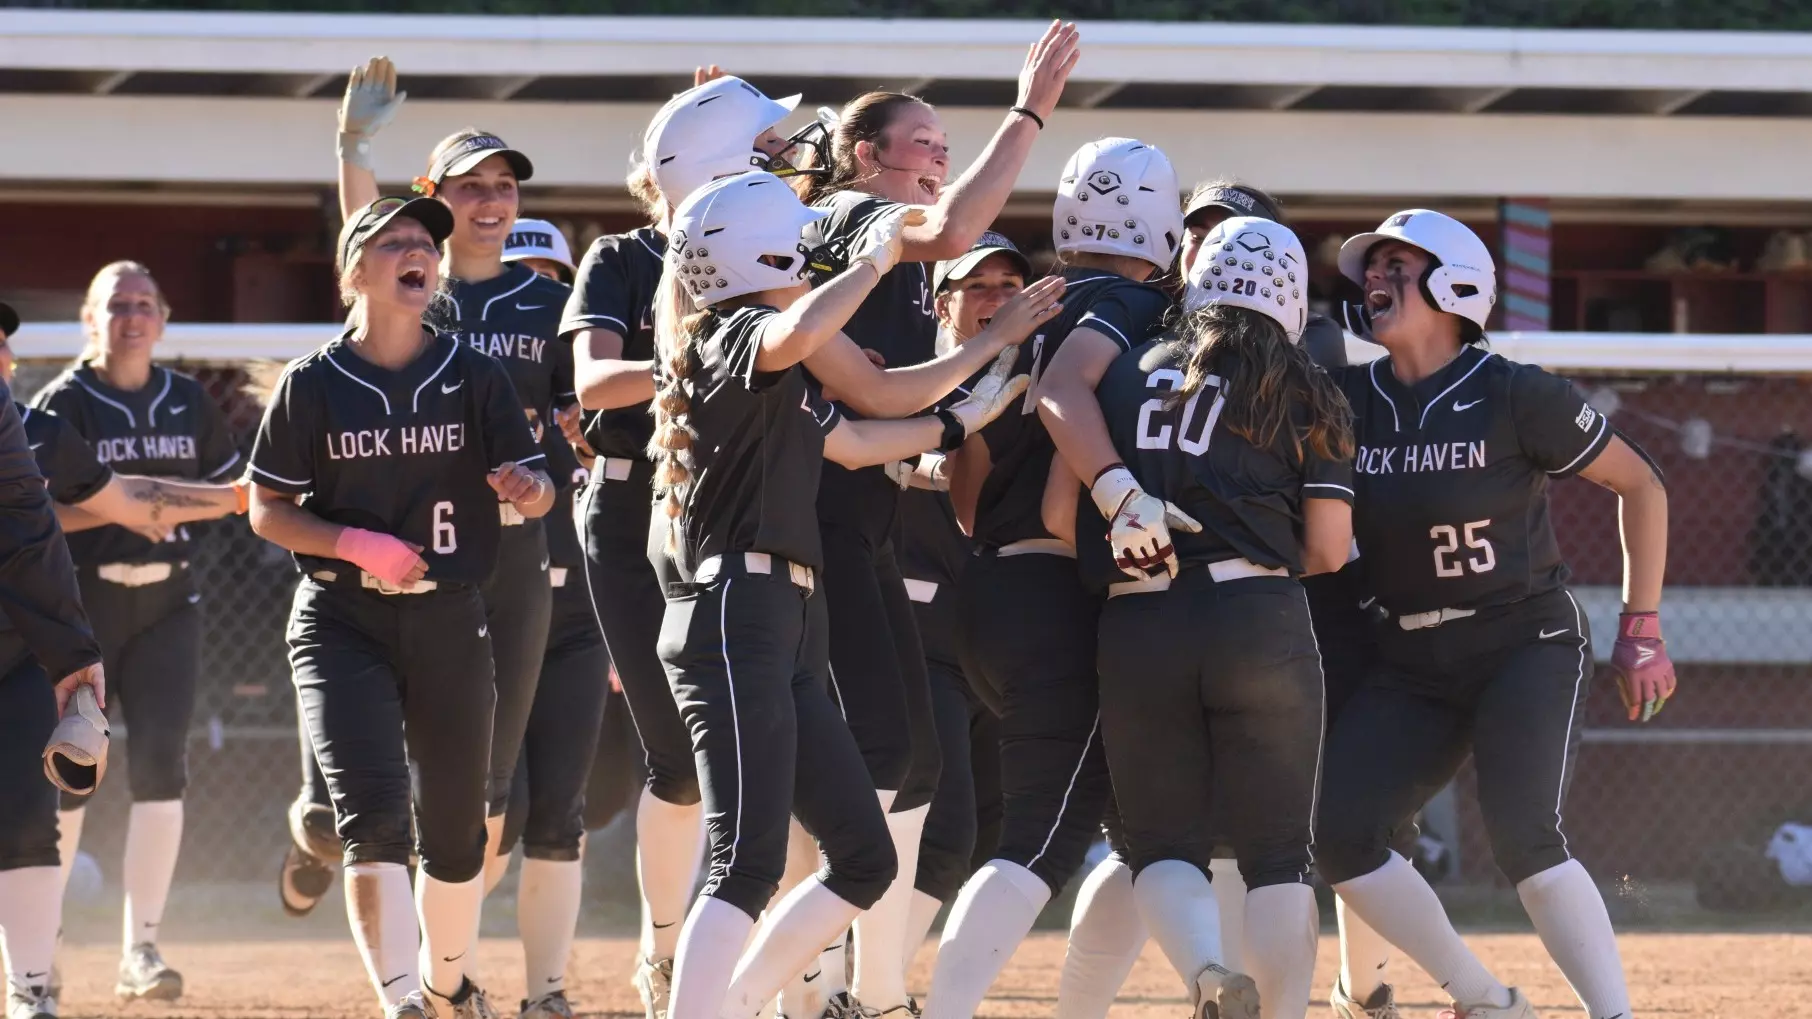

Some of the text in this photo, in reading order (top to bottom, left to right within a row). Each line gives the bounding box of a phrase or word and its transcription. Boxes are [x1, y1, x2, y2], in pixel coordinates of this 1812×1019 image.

[1095, 224, 1106, 241] 7
[1232, 277, 1257, 297] 20
[470, 333, 546, 364] HAVEN
[1136, 368, 1230, 457] 20
[97, 437, 140, 464] OCK
[327, 428, 392, 460] LOCK
[1355, 440, 1486, 475] OCK HAVEN
[433, 501, 458, 555] 6
[1429, 518, 1496, 578] 25
